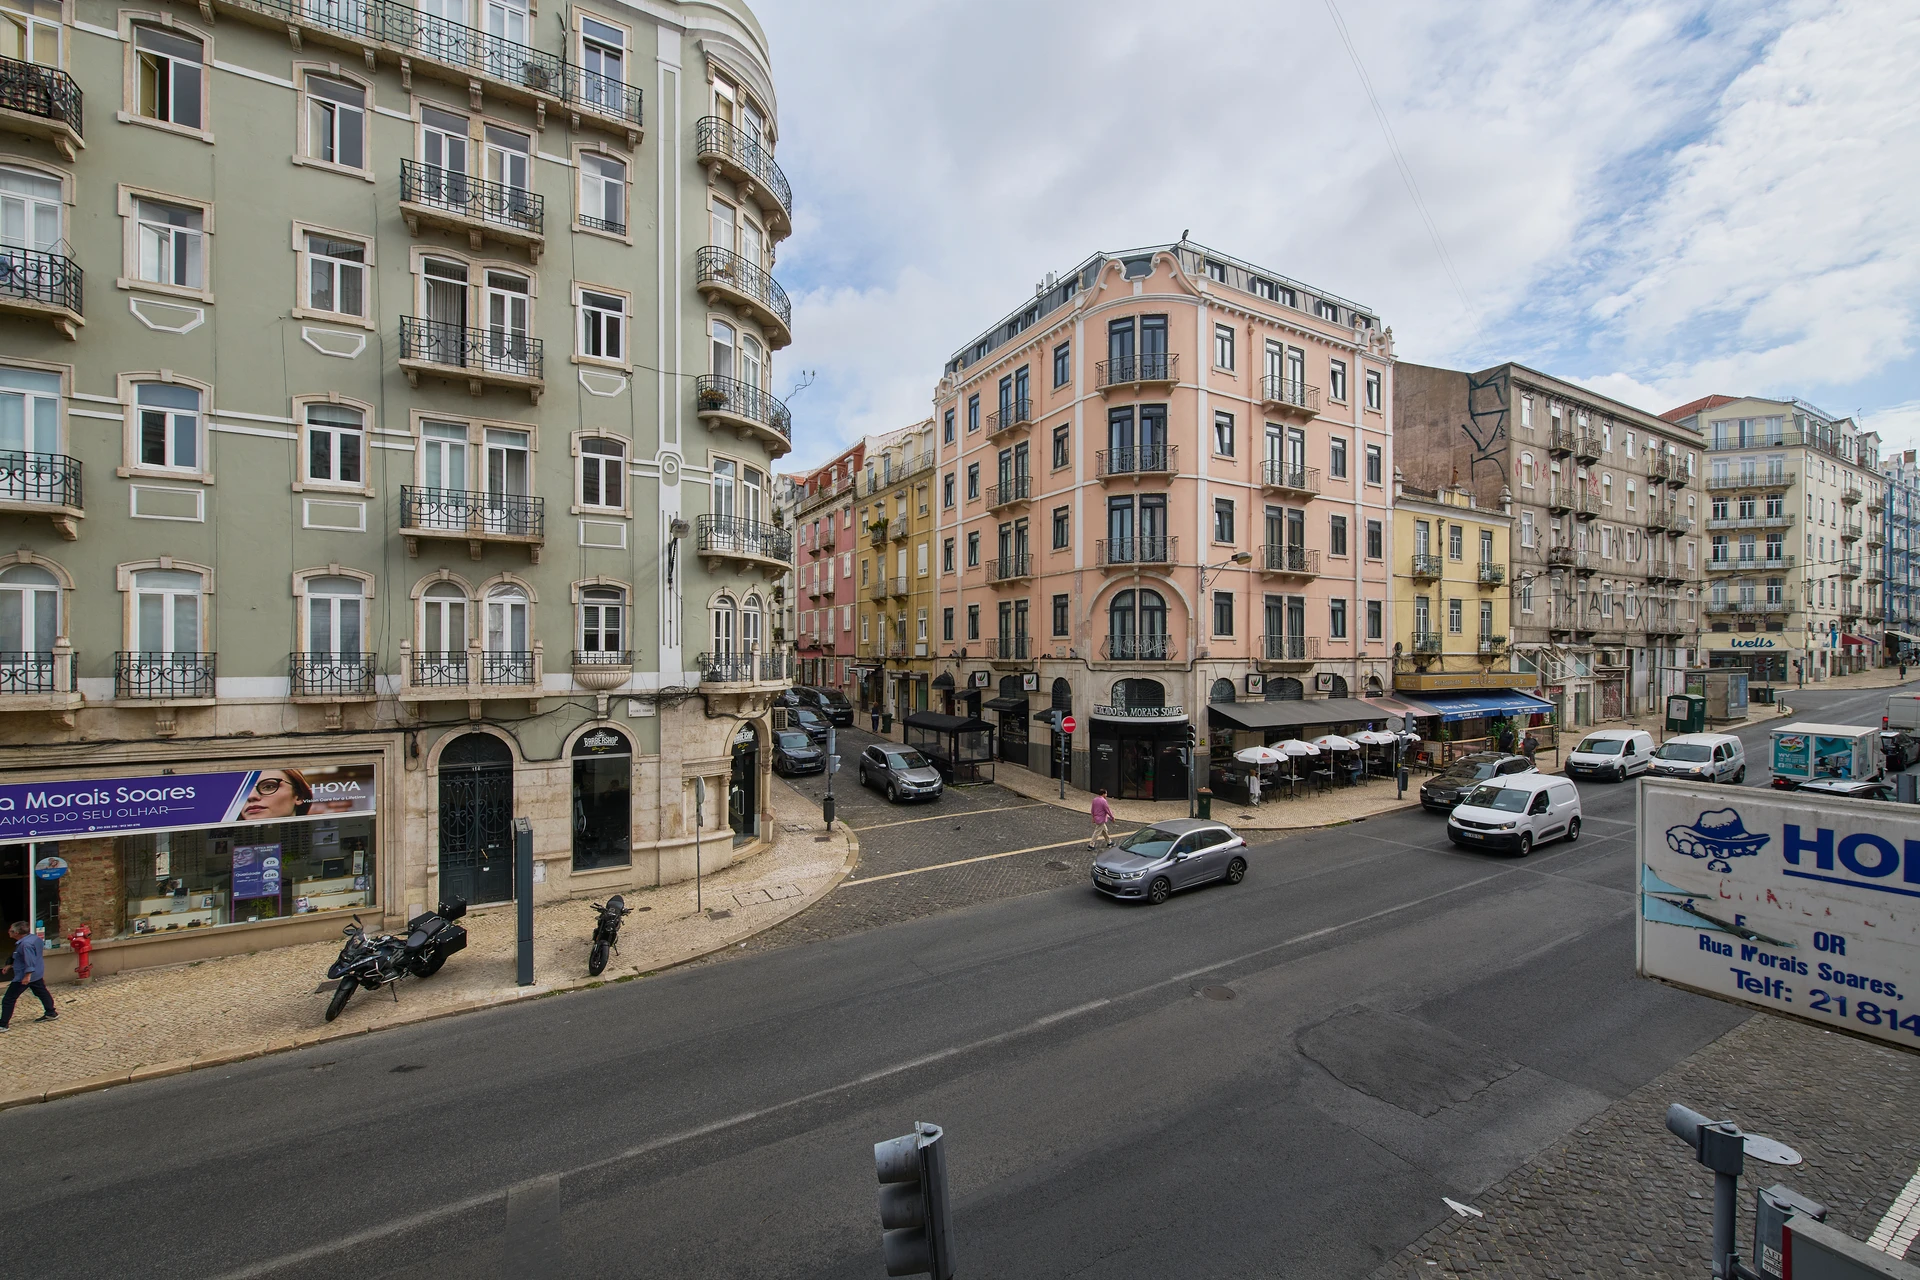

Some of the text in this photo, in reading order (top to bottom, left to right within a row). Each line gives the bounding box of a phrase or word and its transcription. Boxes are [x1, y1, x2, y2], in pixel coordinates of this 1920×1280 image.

[1731, 637, 1775, 648] wells
[1129, 707, 1159, 717] MORAIS
[1160, 706, 1184, 717] SOARES
[309, 781, 361, 794] HOYA
[25, 788, 110, 810] Morais
[115, 786, 196, 804] Soares
[54, 812, 78, 823] DO
[82, 809, 112, 820] SEU
[117, 806, 168, 818] OLHAR
[1813, 931, 1846, 956] OR
[1699, 934, 1904, 1001] Rua Morais Soares,
[1730, 967, 1793, 1002] Telf:
